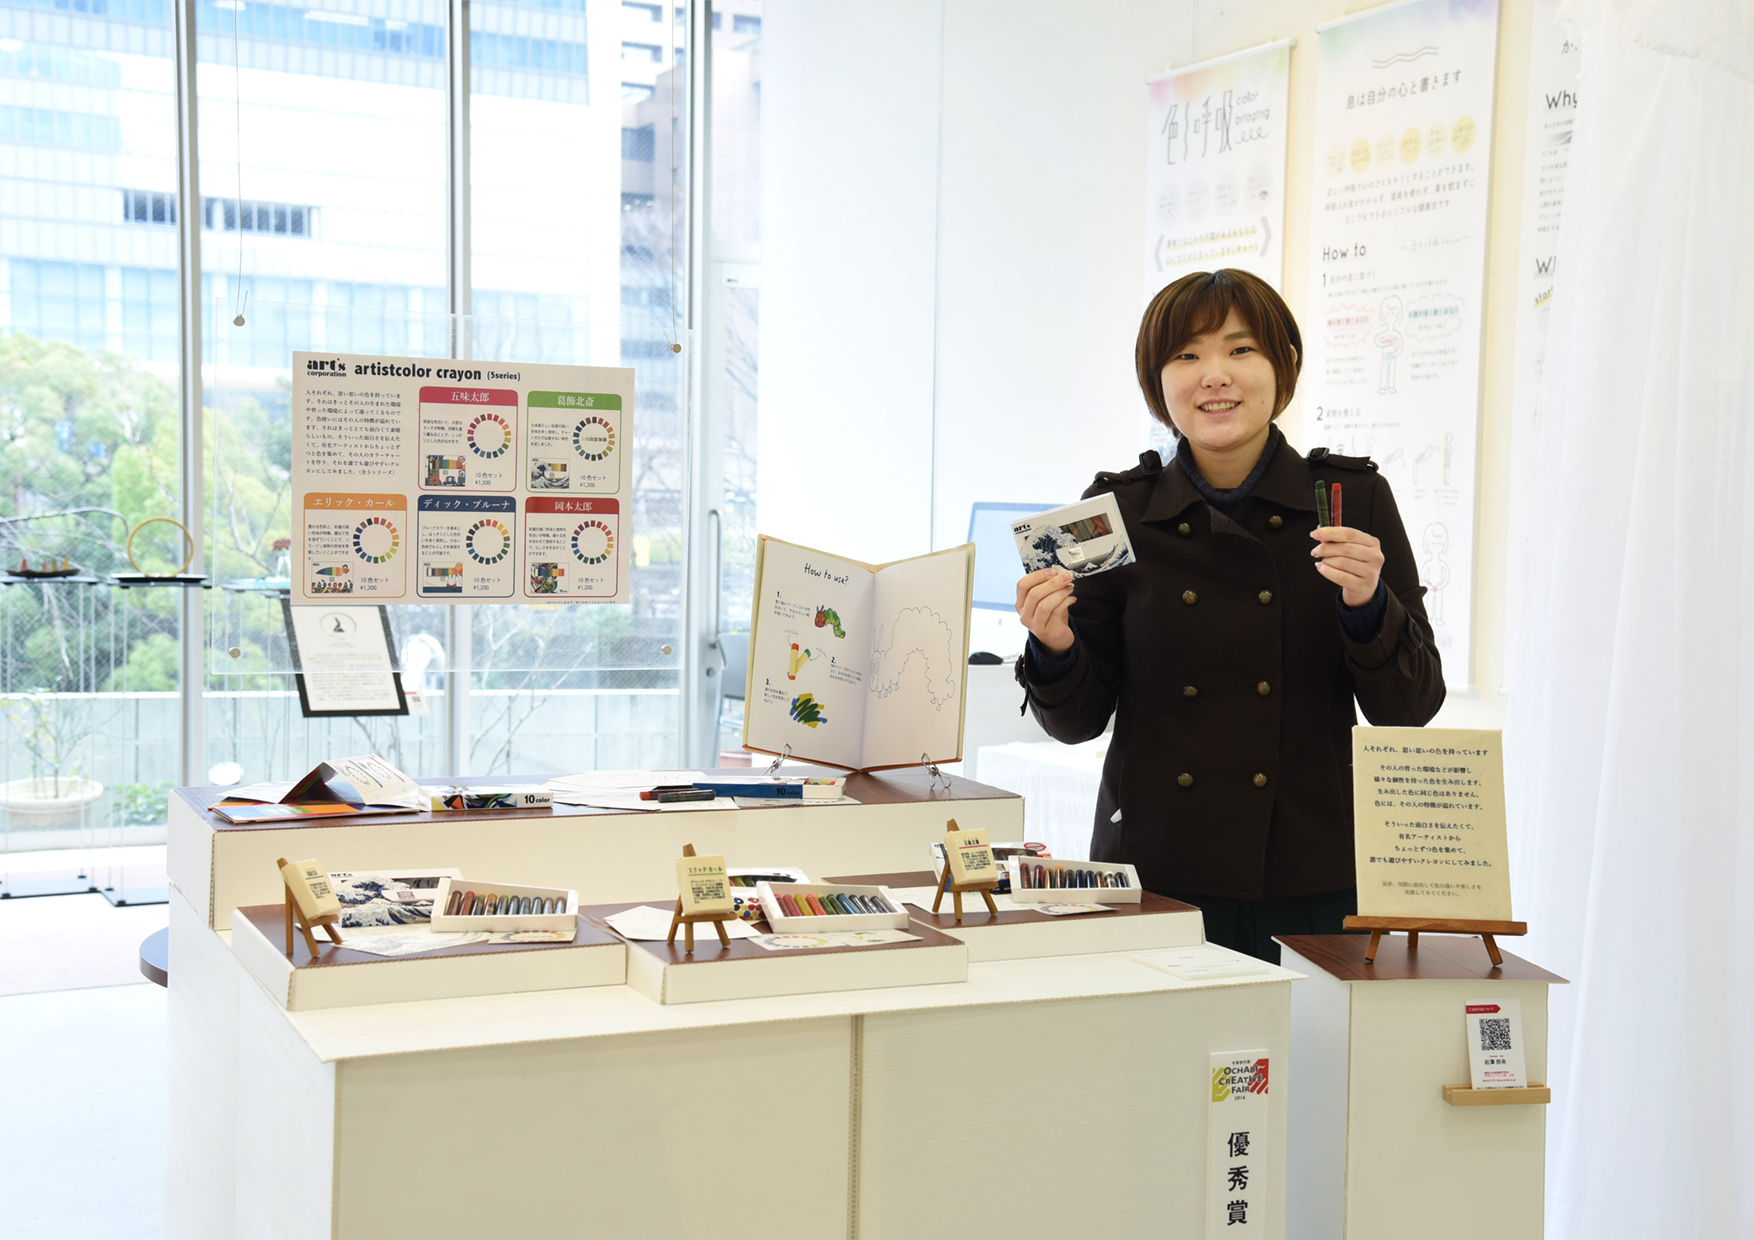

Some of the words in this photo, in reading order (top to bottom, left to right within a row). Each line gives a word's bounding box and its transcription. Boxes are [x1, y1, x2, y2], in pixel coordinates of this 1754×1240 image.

[1346, 69, 1462, 110] 息は自分の心と書きます
[1235, 91, 1259, 106] color
[1323, 246, 1348, 262] How
[1354, 243, 1367, 257] to
[354, 362, 432, 378] artistcolor
[436, 368, 482, 382] crayon
[487, 371, 521, 382] (5series)
[306, 390, 401, 399] 人それぞれ、思い思いの色を持っていま
[450, 391, 490, 403] 五味太郎
[557, 395, 595, 407] 葛飾北斎
[1316, 406, 1323, 421] 2
[313, 497, 395, 508] エリック・カール
[423, 498, 510, 510] ディック・ブルーナ
[554, 501, 592, 511] 岡本太郎
[804, 562, 821, 577] How
[824, 569, 832, 580] to
[834, 574, 849, 586] use?
[1363, 745, 1488, 757] 人それぞれ、思い思いの色を持っています
[1380, 764, 1472, 774] その人の育った環境などが影響し
[1374, 776, 1482, 786] 様々な個性を持った色を生み出します。
[775, 786, 786, 796] 10
[1377, 788, 1479, 798] 生み出した色に同じ色はありません。
[523, 794, 535, 805] 10
[1374, 800, 1483, 811] 色には、その人の特徴が溢れています。
[1384, 820, 1475, 831] そういった面白さを伝えたくて、
[1398, 833, 1461, 842] 有名アーティストから
[1394, 845, 1466, 854] ちょっとずつ色を集めて、
[1370, 856, 1492, 867] 誰でも遊びやすいクレヨンにしてみました。
[1223, 1064, 1259, 1076] OCHABI
[1218, 1073, 1263, 1086] CREATIVE
[1231, 1085, 1250, 1094] FAIR
[1227, 1131, 1250, 1226] 優秀賞
